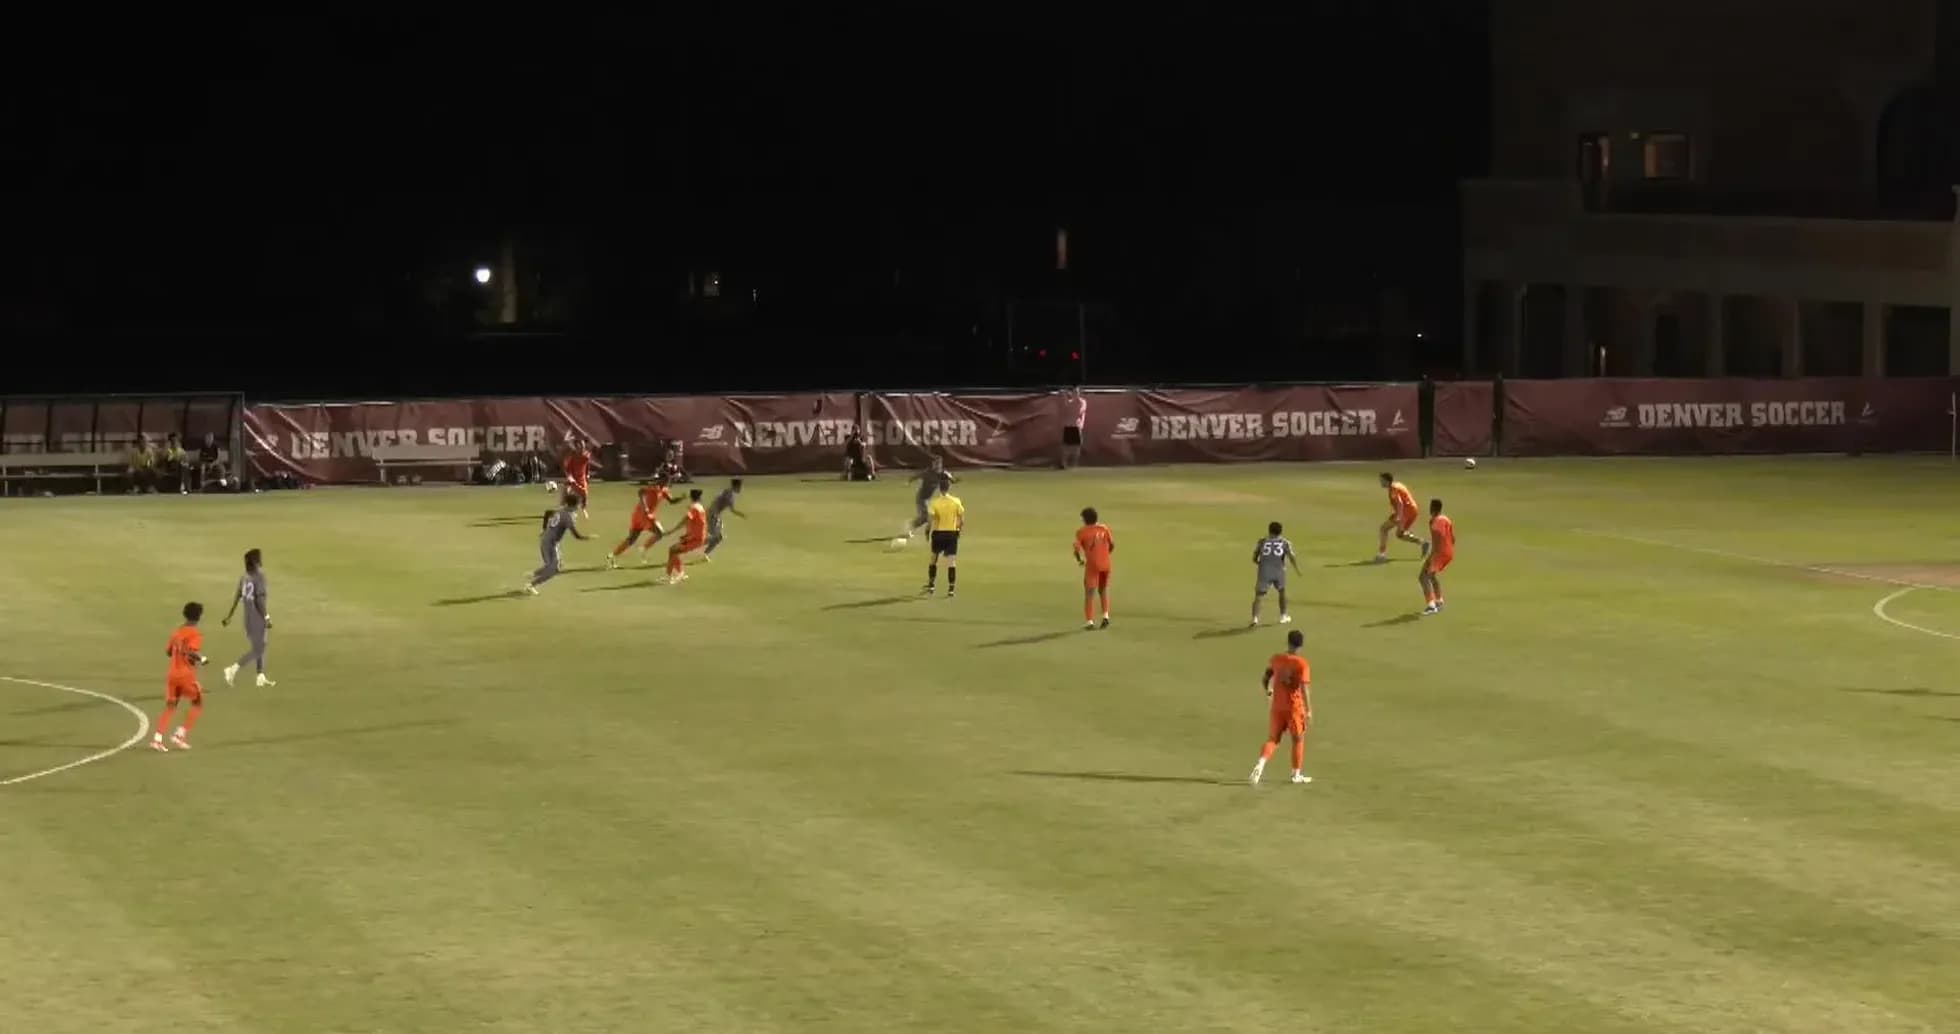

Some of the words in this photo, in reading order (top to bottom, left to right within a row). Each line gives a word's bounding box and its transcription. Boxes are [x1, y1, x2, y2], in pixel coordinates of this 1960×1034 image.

[1150, 413, 1264, 439] DENVER
[1272, 409, 1377, 436] SOCCER
[1638, 403, 1744, 428] DENVER
[1751, 401, 1845, 425] SOCCER
[866, 419, 978, 446] SOCCER
[1263, 542, 1284, 556] 53
